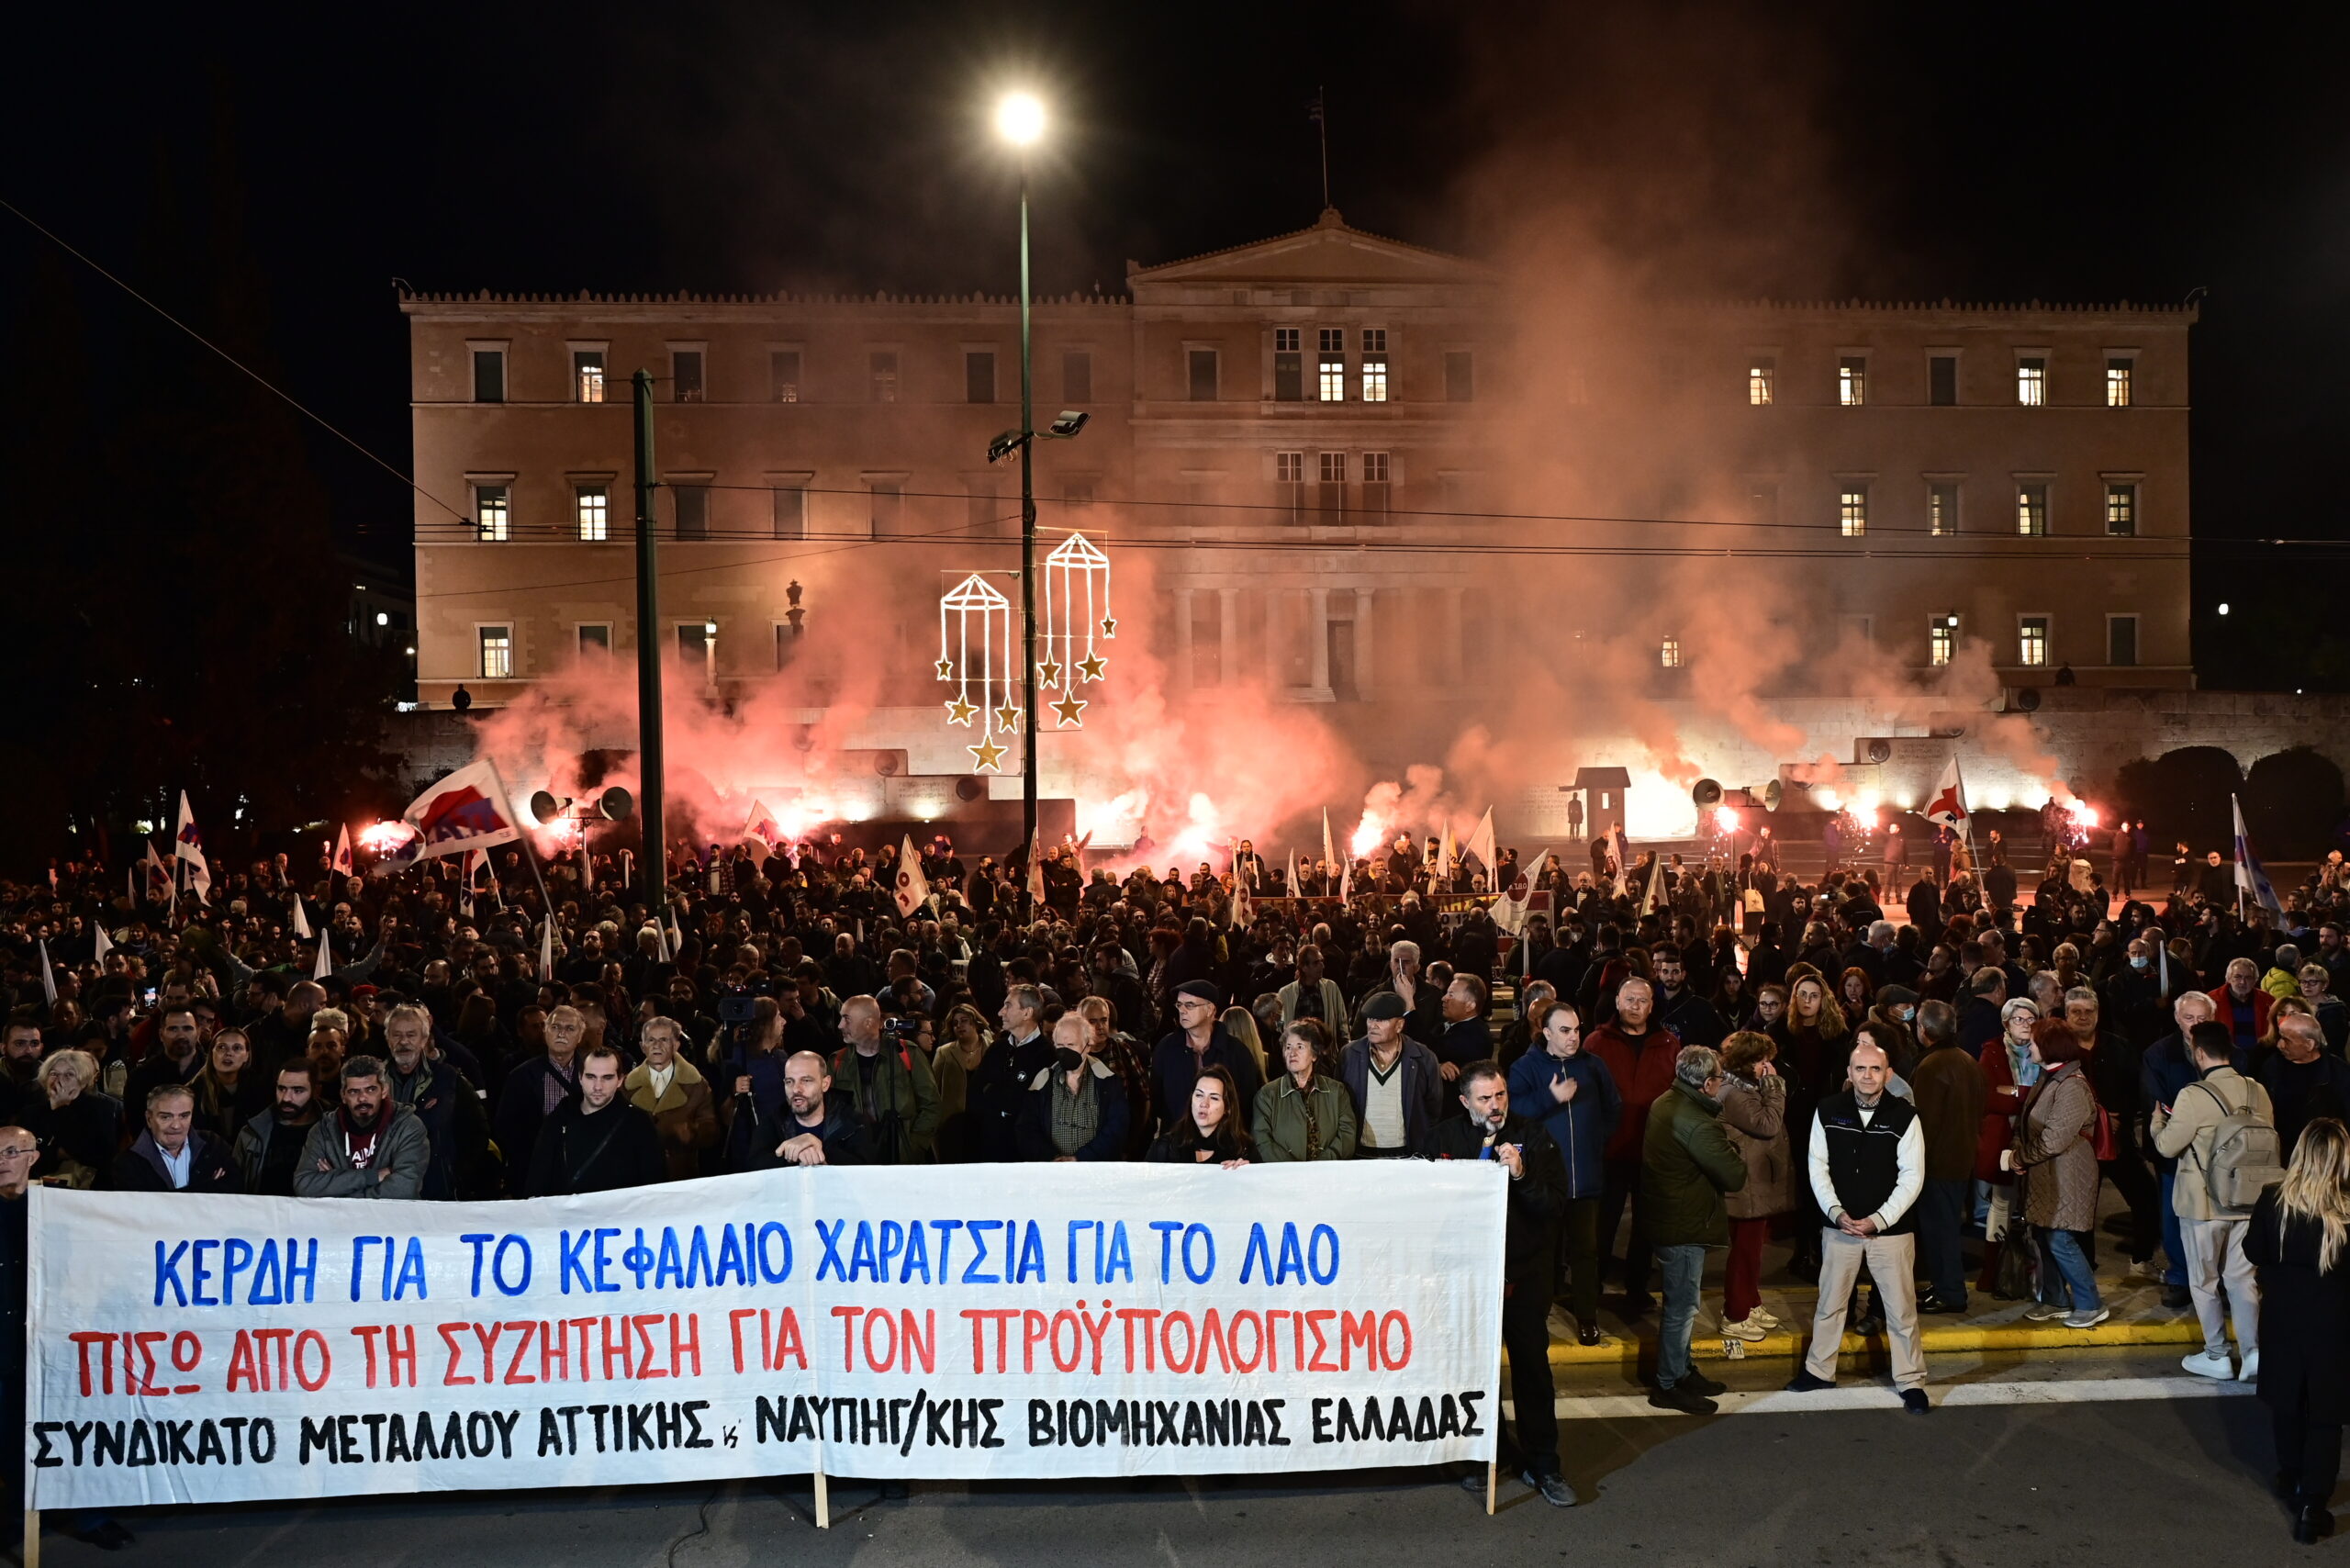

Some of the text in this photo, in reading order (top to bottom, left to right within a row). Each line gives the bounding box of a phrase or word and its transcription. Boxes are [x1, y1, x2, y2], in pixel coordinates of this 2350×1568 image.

[154, 1219, 1340, 1307] ΚΕΡΔΗ ΓΙΑ ΤΟ ΚΕΦΑΛΑΙΟ ΧΑΡΑΤΣΙΑ ΓΙΑ ΤΟ ΛΑΟ
[69, 1299, 1413, 1396] ΠΙΣΩ ΑΠΟ ΤΗ ΣΥΖΗΤΗΣΗ ΓΙΑ ΤΟΝ ΠΡΟΫΠΟΛΟΓΙΣΜΟ
[33, 1417, 276, 1469] ΣΥΝΔΙΚΑΤΟ
[299, 1410, 520, 1466] ΜΕΤΑΛΛΟΥ
[538, 1400, 714, 1457] ΑΤΤΙΚΗΣ
[755, 1389, 1005, 1458] ΝΑΥΠΗΓ/ΚΗΣ
[1028, 1398, 1292, 1449] ΒΙΟΜΗΧΑΝΙΑΣ
[1312, 1390, 1486, 1444] ΕΛΛΑΔΑΣ
